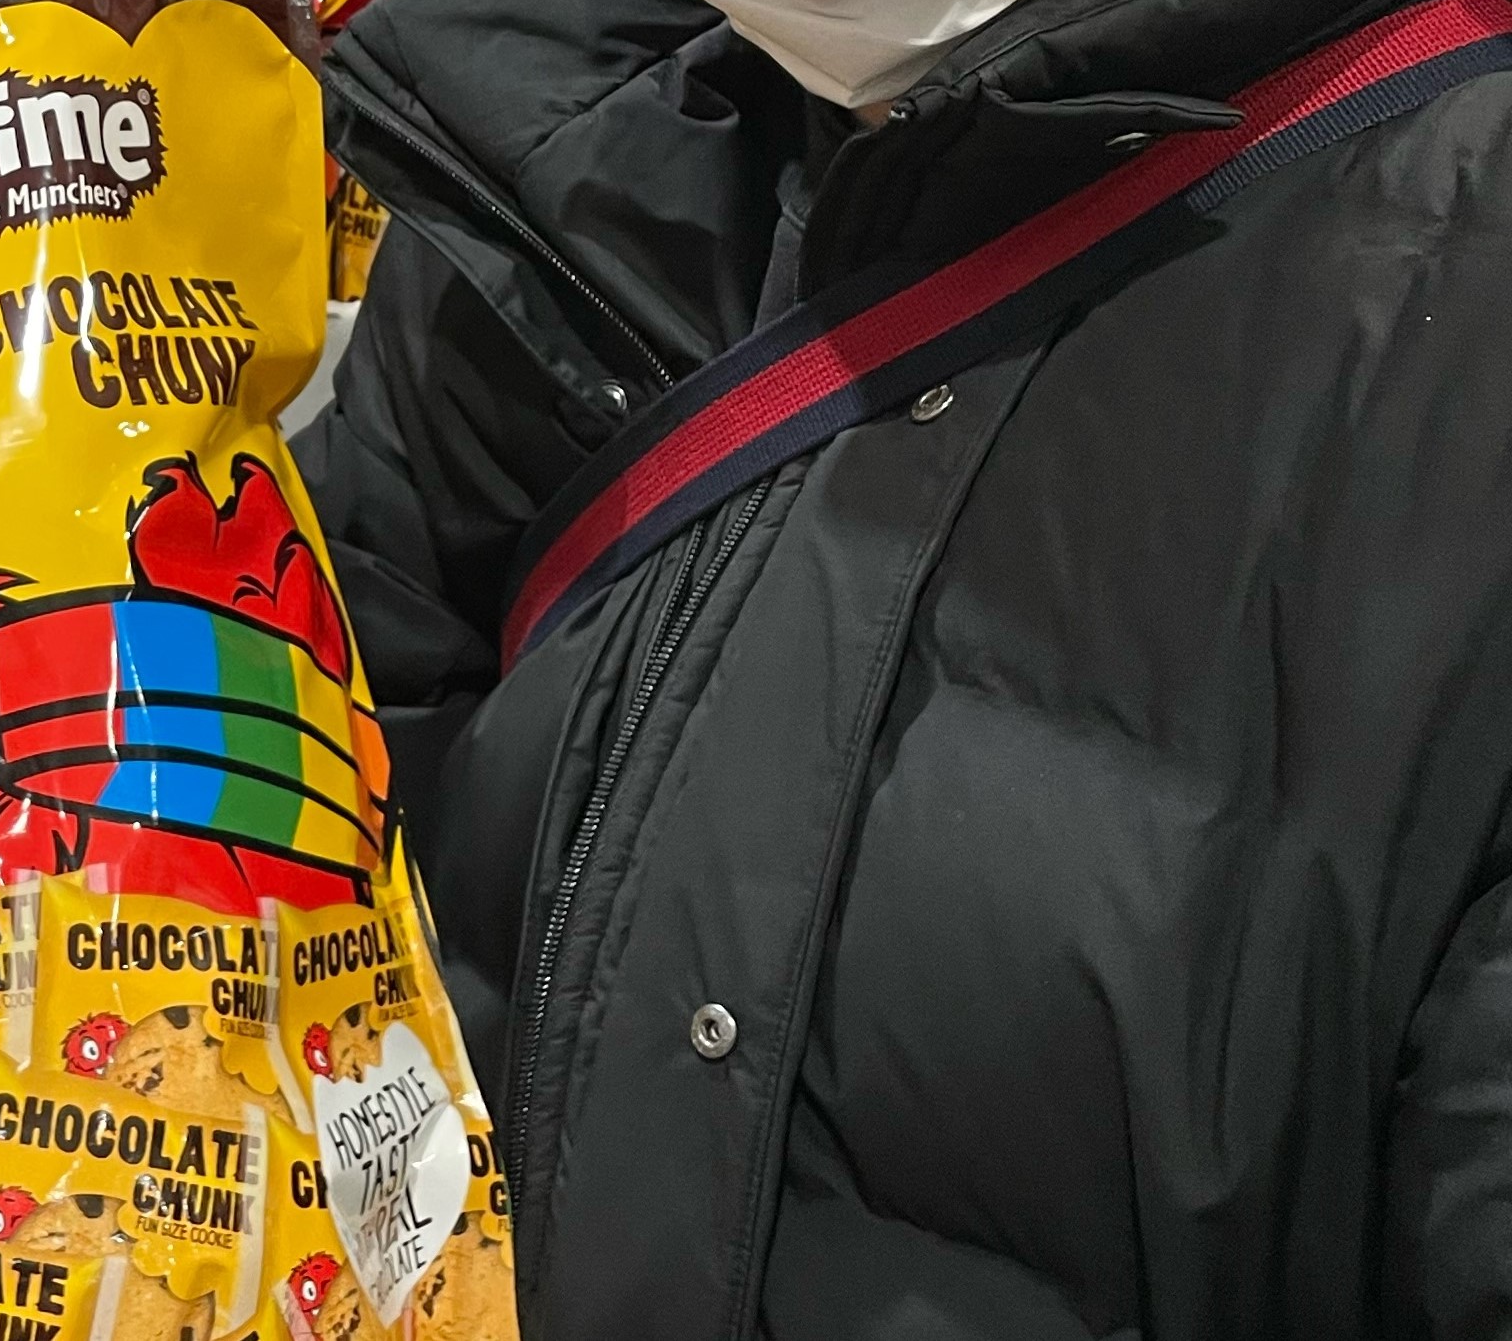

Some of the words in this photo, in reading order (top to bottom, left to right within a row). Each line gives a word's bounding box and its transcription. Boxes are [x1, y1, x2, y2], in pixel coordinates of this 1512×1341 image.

[6, 173, 123, 220] Munchers
[325, 1065, 437, 1172] HOMESTYLE
[132, 1172, 256, 1236] CHUNK
[136, 1215, 158, 1234] FUN
[161, 1218, 189, 1241] SIZE
[189, 1223, 235, 1250] COOKIE
